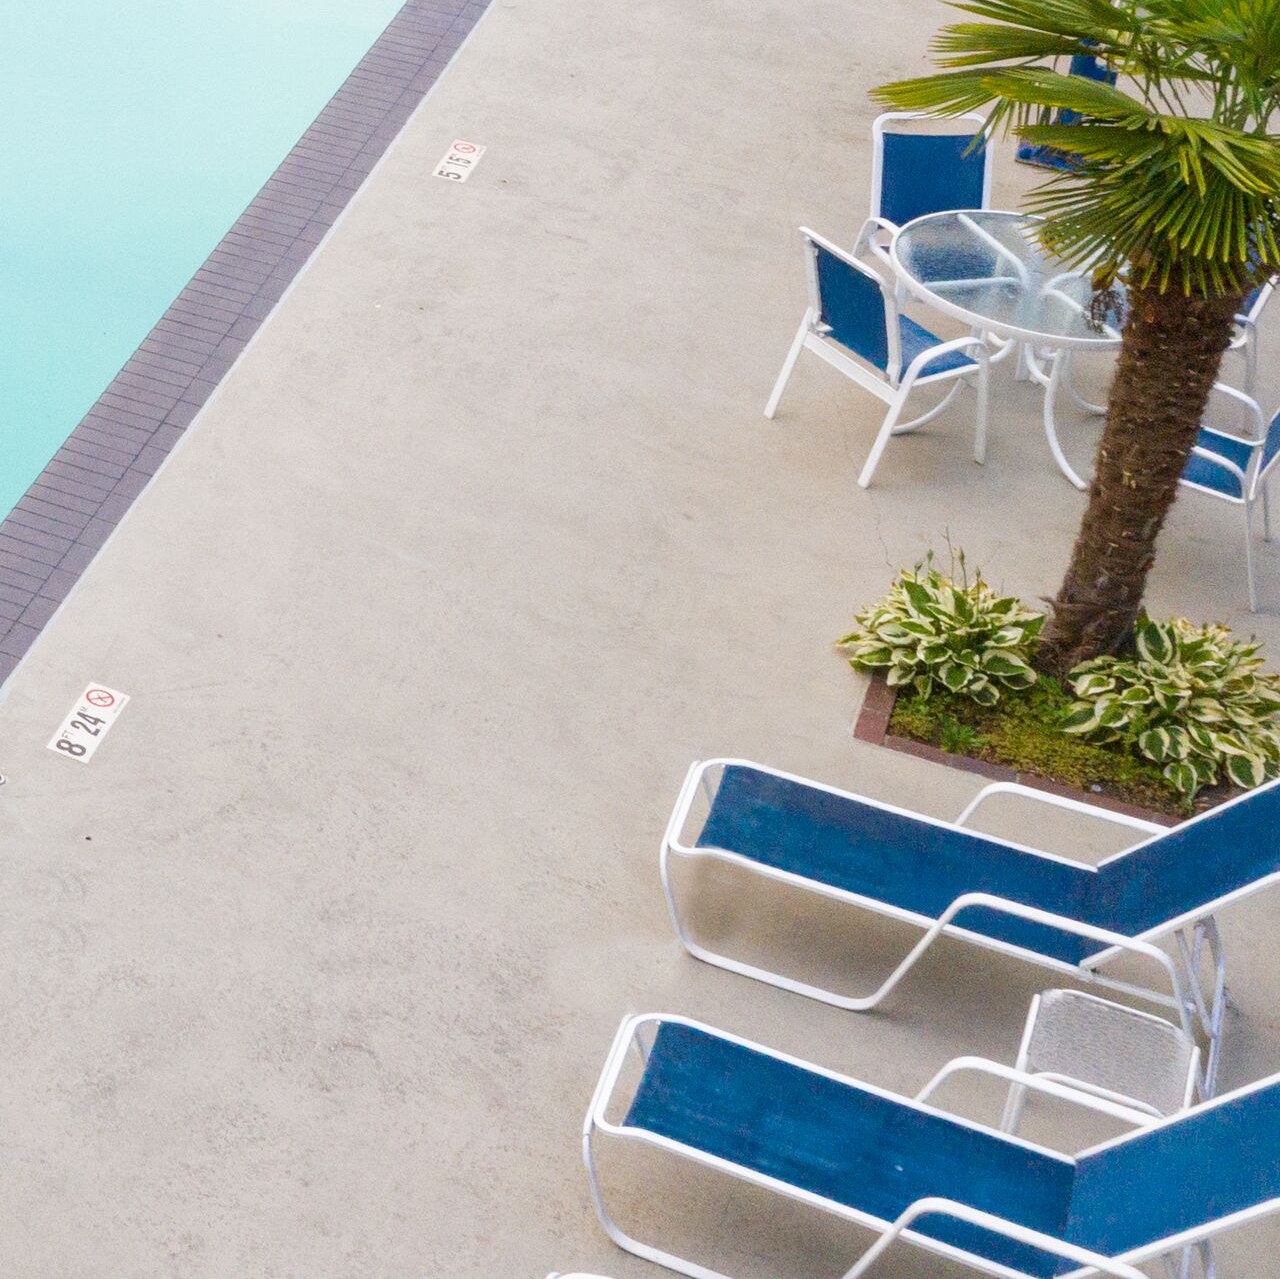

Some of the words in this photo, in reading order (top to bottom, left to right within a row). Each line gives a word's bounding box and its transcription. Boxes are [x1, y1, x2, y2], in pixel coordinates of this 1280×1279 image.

[438, 170, 462, 180] 5
[61, 729, 74, 740] FT
[56, 739, 87, 757] 8
